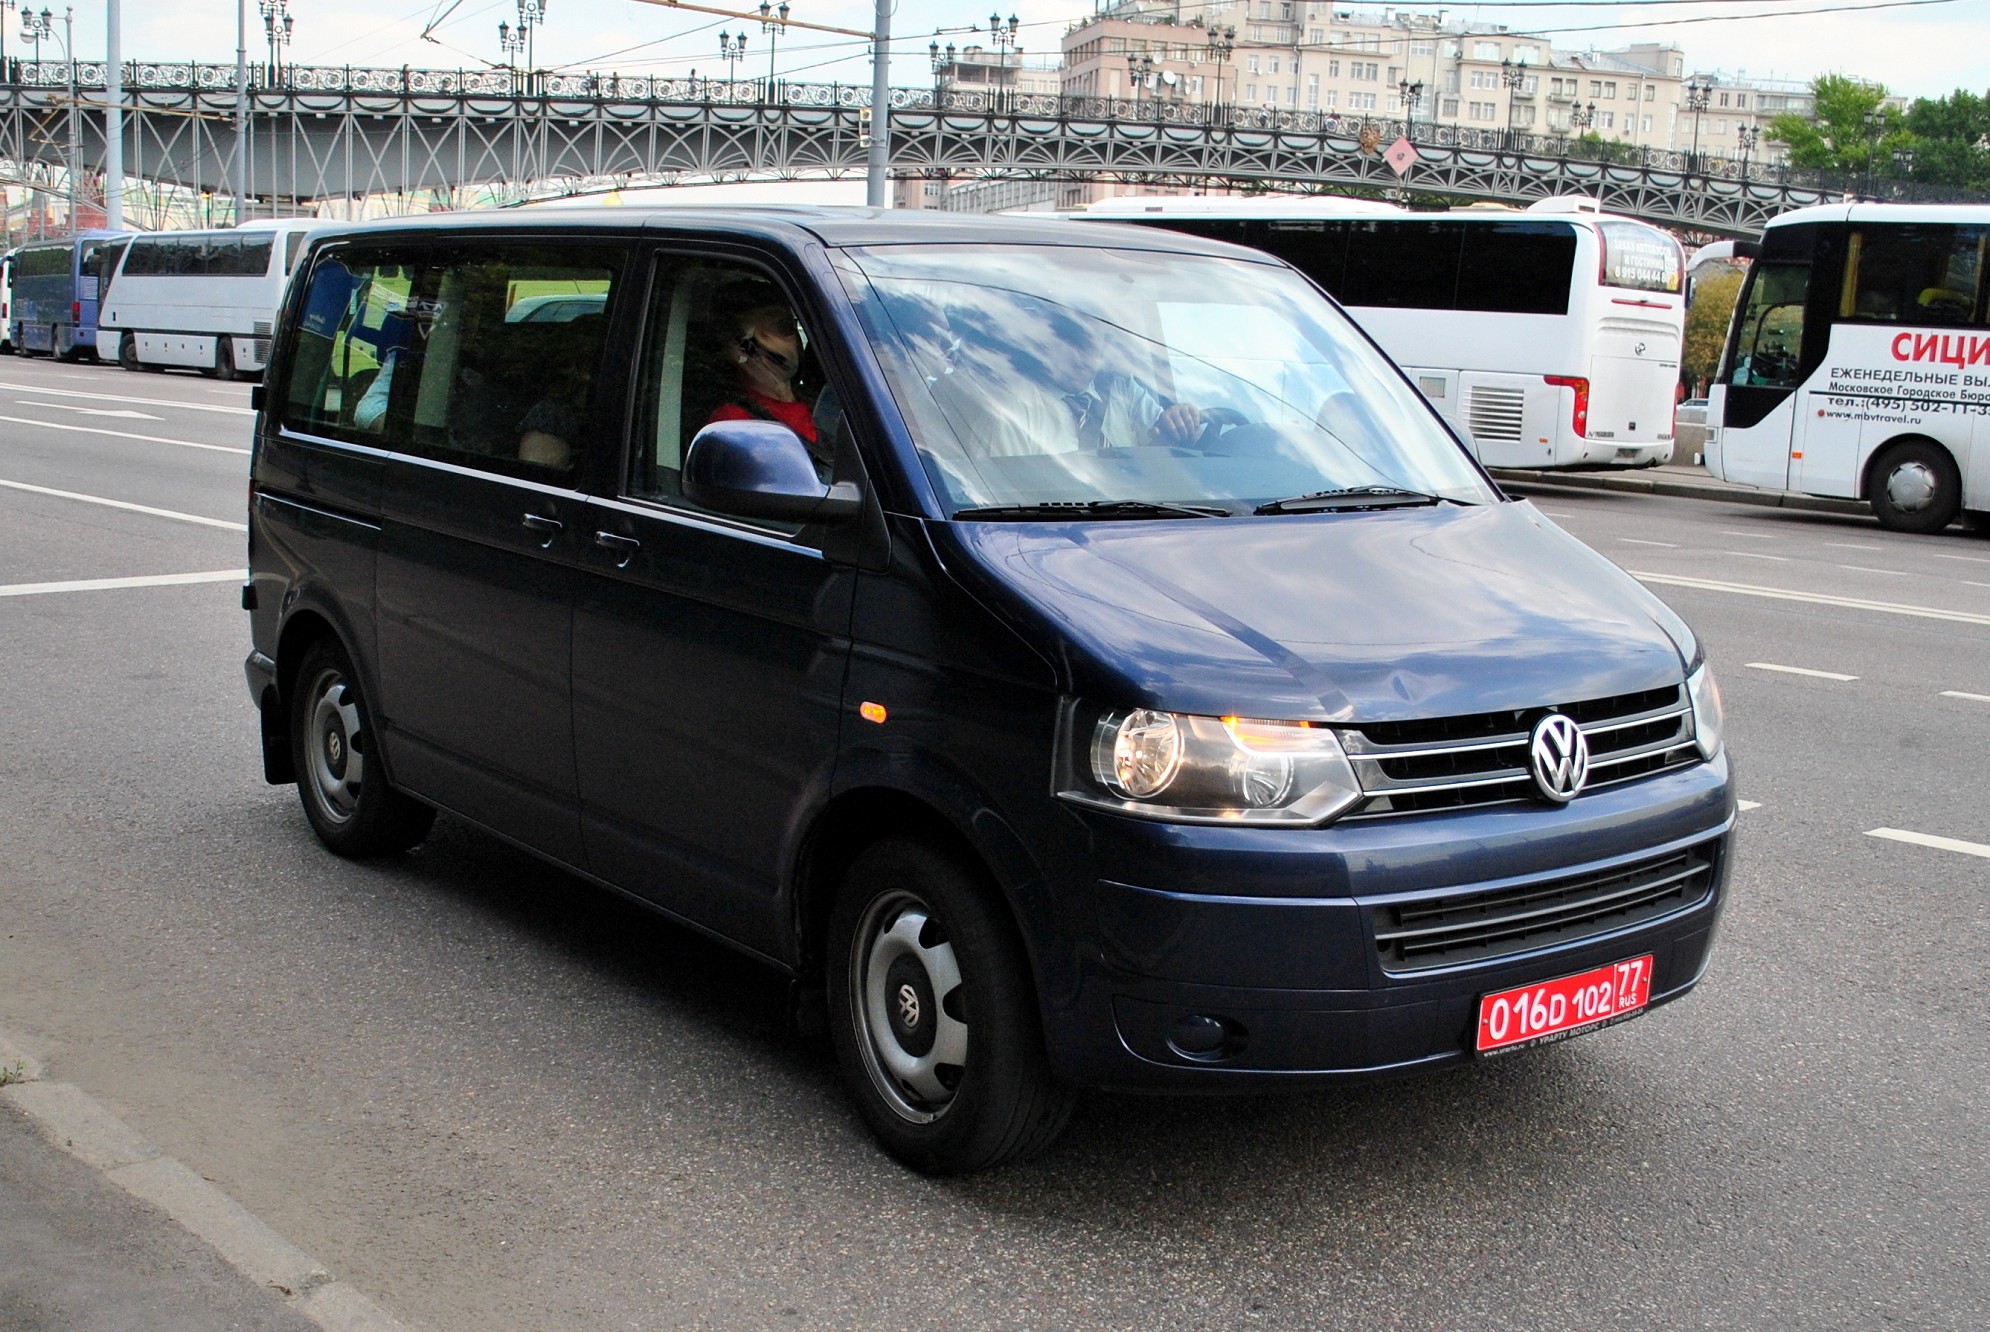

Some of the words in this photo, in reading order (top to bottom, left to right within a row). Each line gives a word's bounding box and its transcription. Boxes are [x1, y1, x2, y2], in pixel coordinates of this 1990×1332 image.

[1891, 332, 1990, 370] СИЦИ
[1830, 367, 1958, 386] ЕЖЕНЕДЕЛЬНЫЕ
[1963, 375, 1990, 387] ВЫ
[1828, 381, 1893, 395] Московское
[1897, 385, 1956, 401] Городское
[1826, 409, 1921, 425] www.mbvtravel.ru
[1910, 401, 1990, 416] 502-11-3
[1617, 960, 1643, 996] 77
[1618, 993, 1636, 1008] RUS
[1539, 1030, 1568, 1046] УРАРТУ
[1569, 1022, 1600, 1037] МОТОРС
